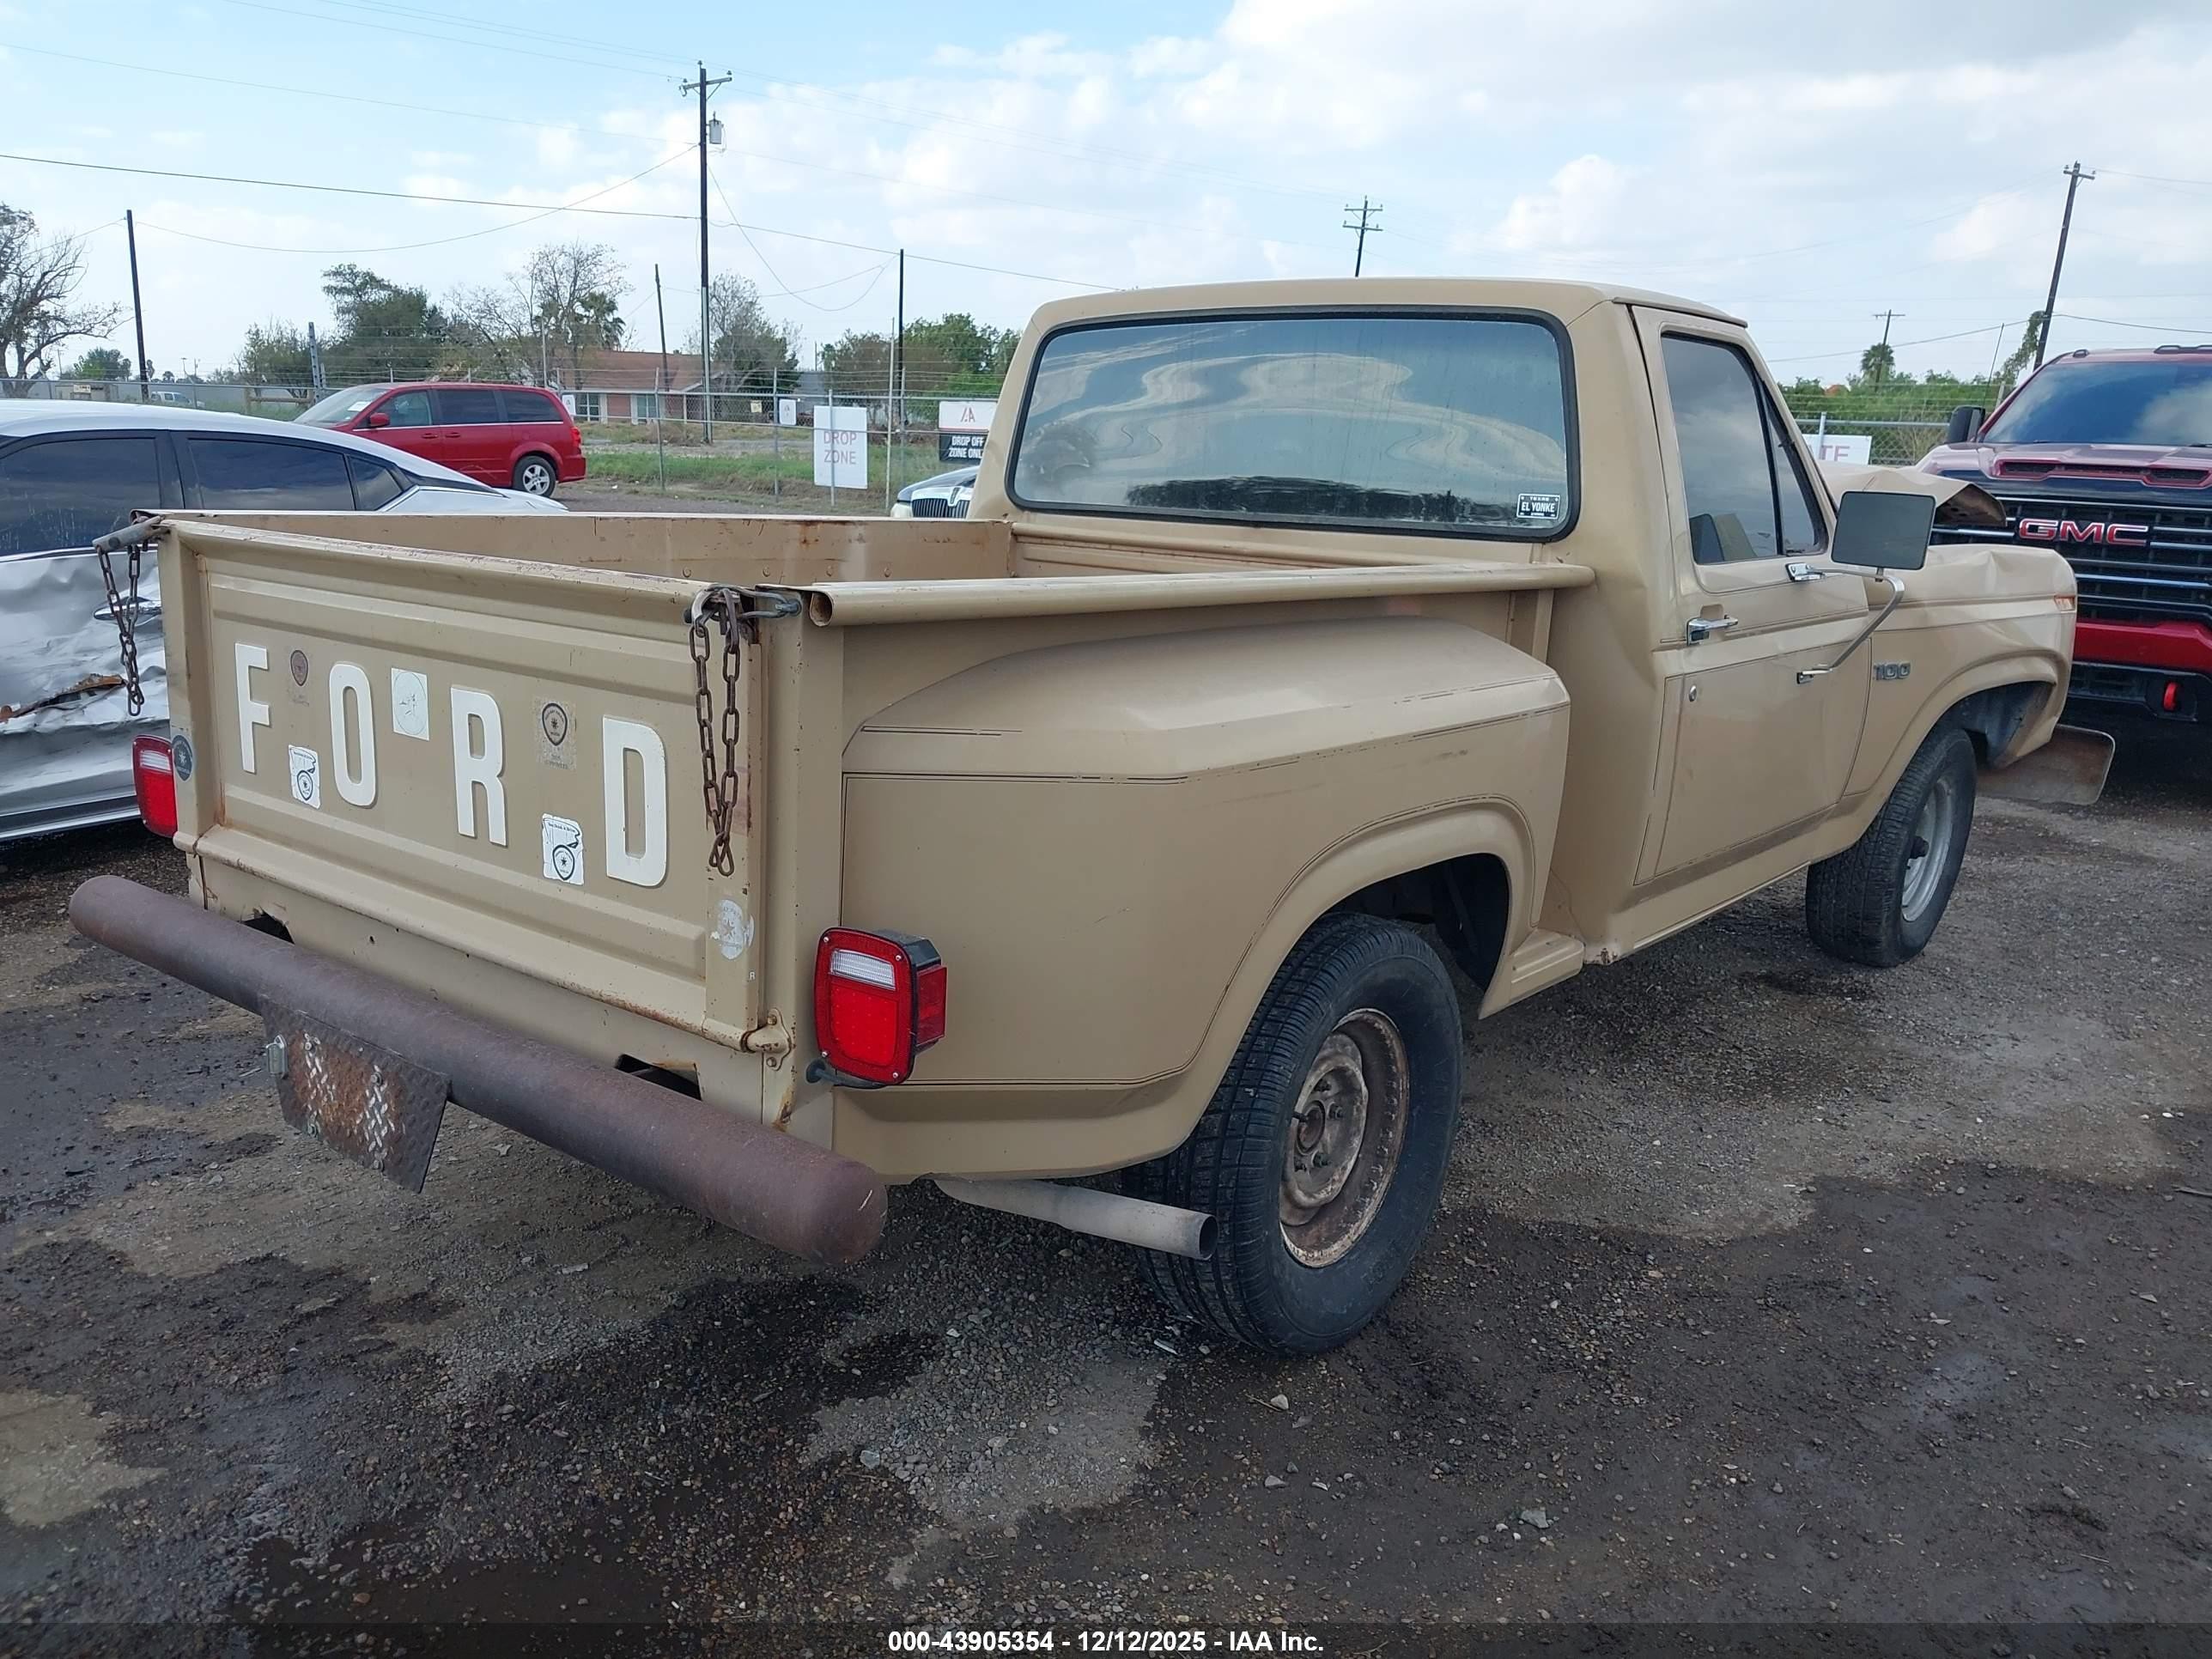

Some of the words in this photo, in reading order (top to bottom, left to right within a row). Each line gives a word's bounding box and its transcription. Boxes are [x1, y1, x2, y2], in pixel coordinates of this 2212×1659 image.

[823, 431, 857, 446] DROP
[951, 435, 970, 447] DROP
[971, 436, 985, 447] OFF
[823, 449, 857, 465] ZONE
[948, 447, 967, 459] ZONE
[968, 448, 983, 459] ONL
[1521, 501, 1530, 512] EL
[1531, 501, 1556, 513] YONKE
[2019, 518, 2148, 547] GMC
